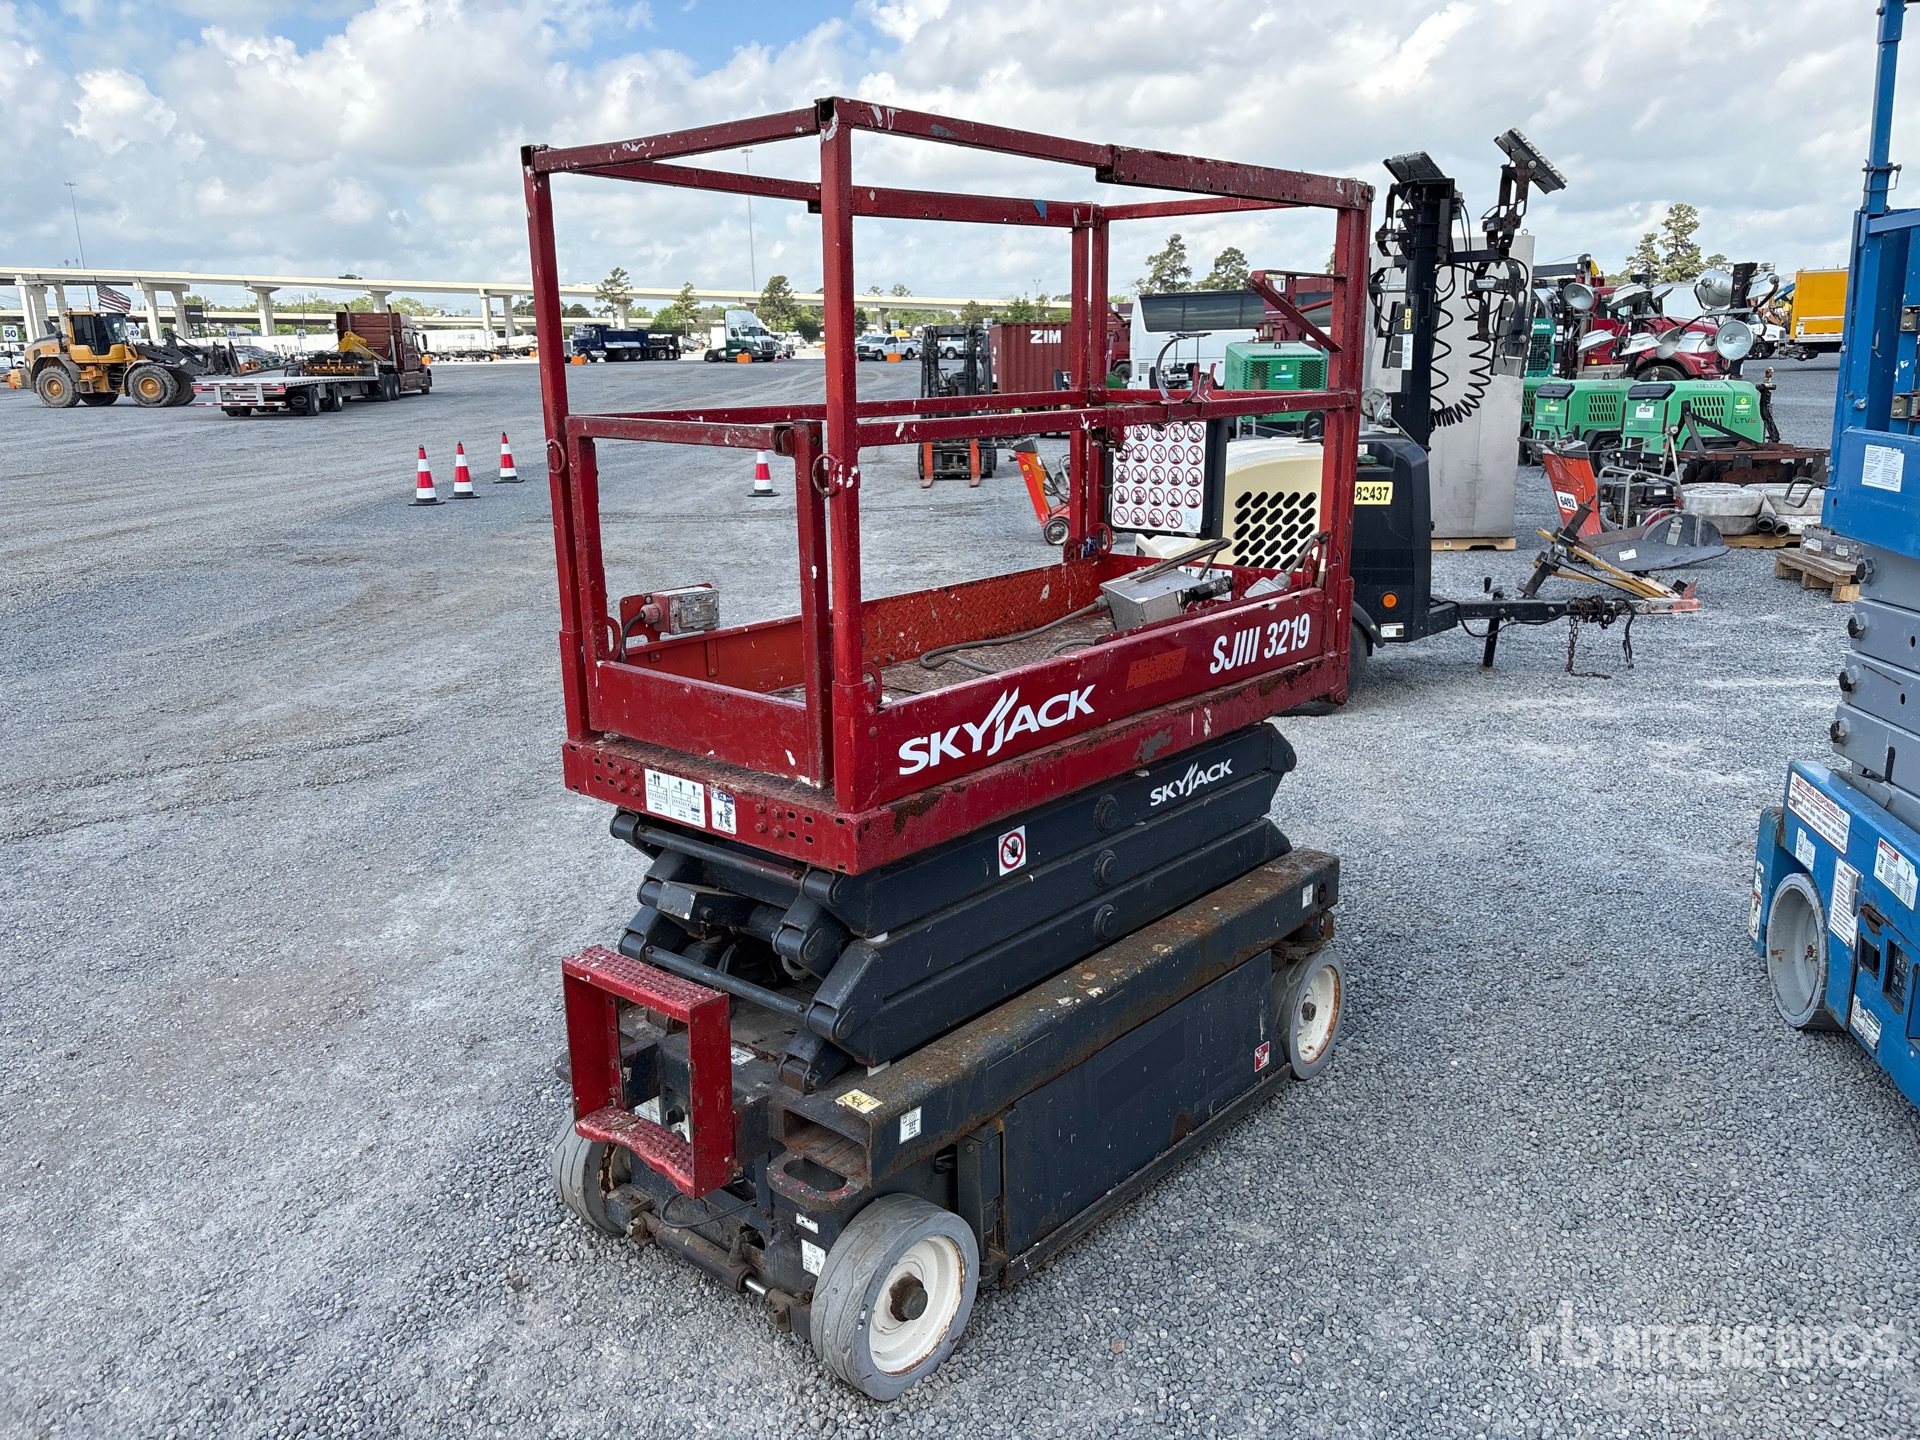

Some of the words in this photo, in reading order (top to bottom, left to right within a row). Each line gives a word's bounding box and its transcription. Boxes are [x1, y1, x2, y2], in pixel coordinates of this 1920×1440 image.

[4, 329, 17, 338] 50
[129, 329, 139, 337] 49
[1030, 329, 1062, 344] ZIM
[1355, 486, 1390, 502] 82437
[1559, 495, 1577, 509] 6492
[1263, 612, 1311, 659] 3219
[898, 684, 1096, 776] SKYJACK
[1150, 758, 1234, 807] SKYJACK
